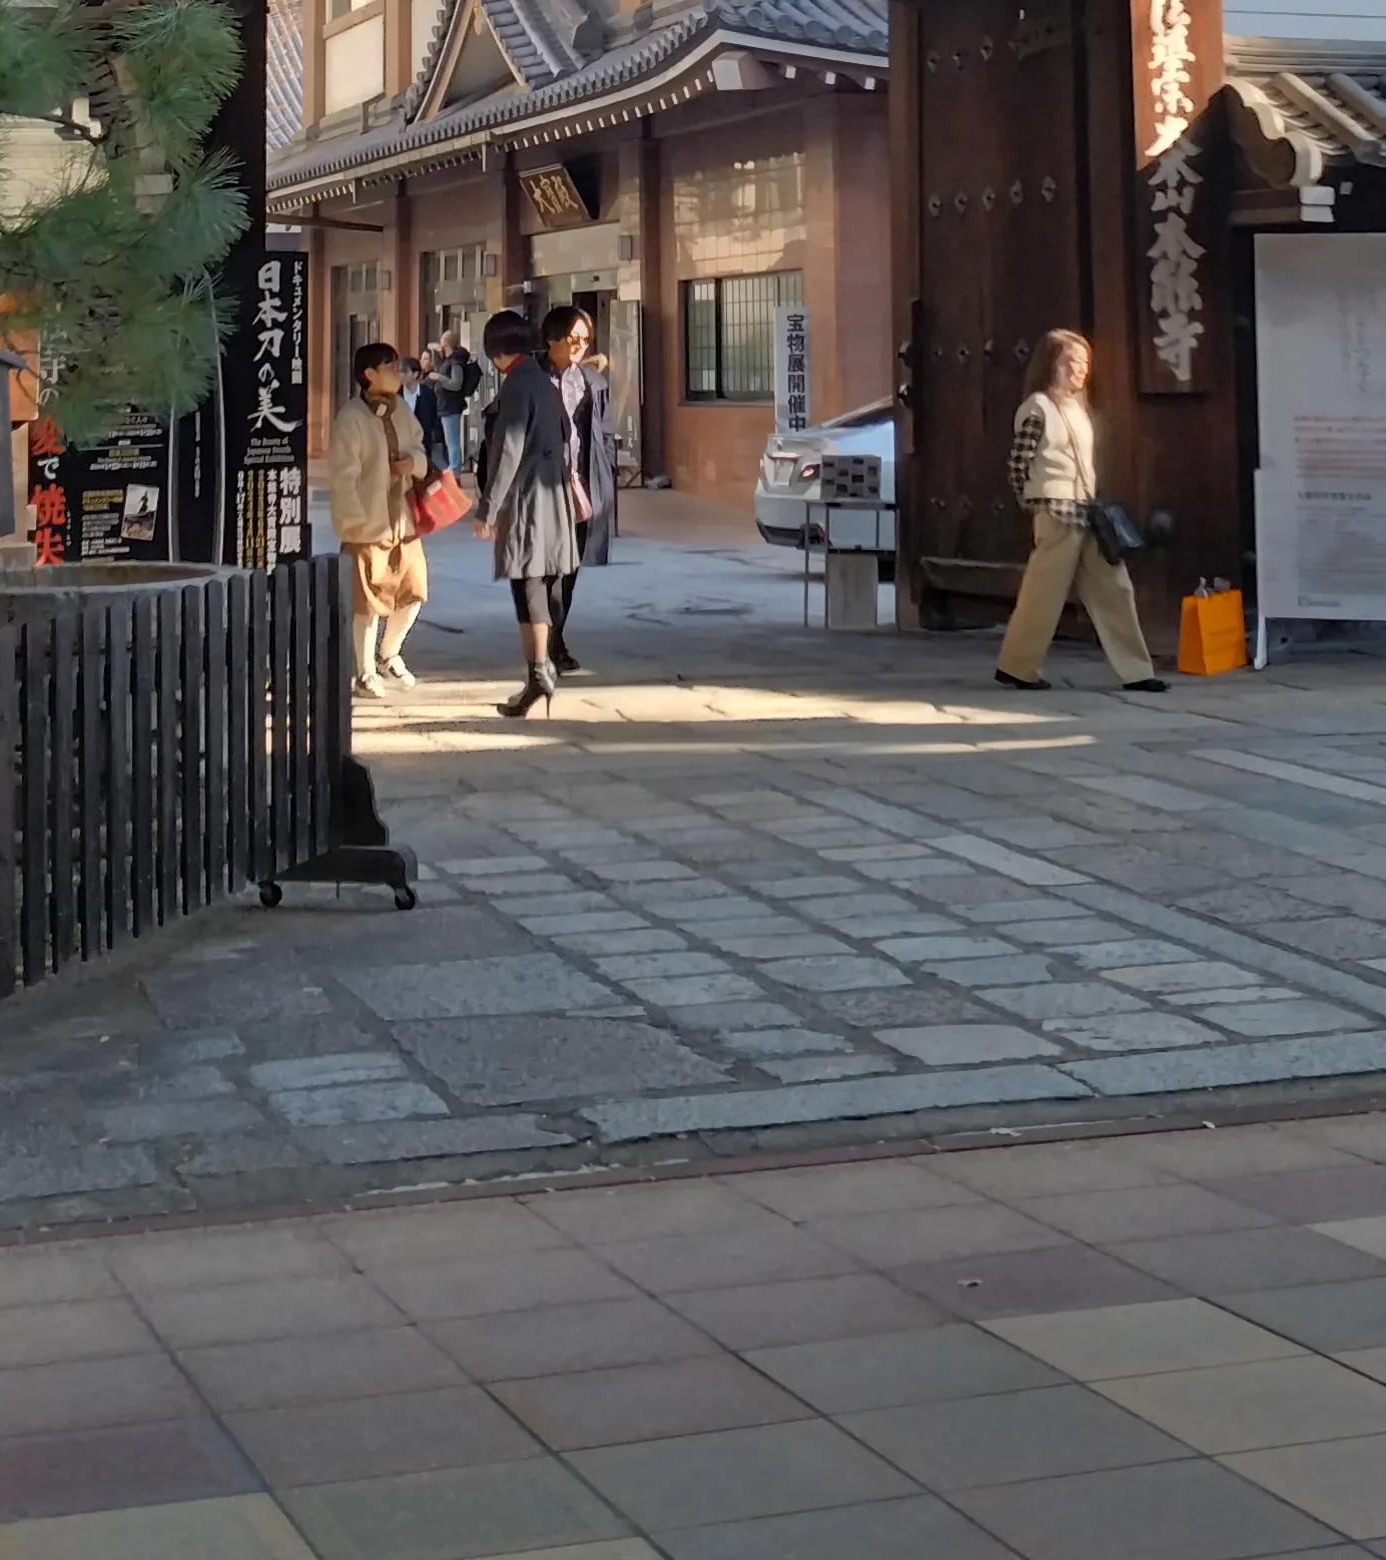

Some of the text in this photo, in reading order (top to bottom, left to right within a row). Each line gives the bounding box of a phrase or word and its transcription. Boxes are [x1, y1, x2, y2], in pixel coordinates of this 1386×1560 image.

[247, 260, 303, 432] 日本刀の美
[786, 313, 806, 433] 宝物展開催中
[279, 466, 301, 554] 特別展
